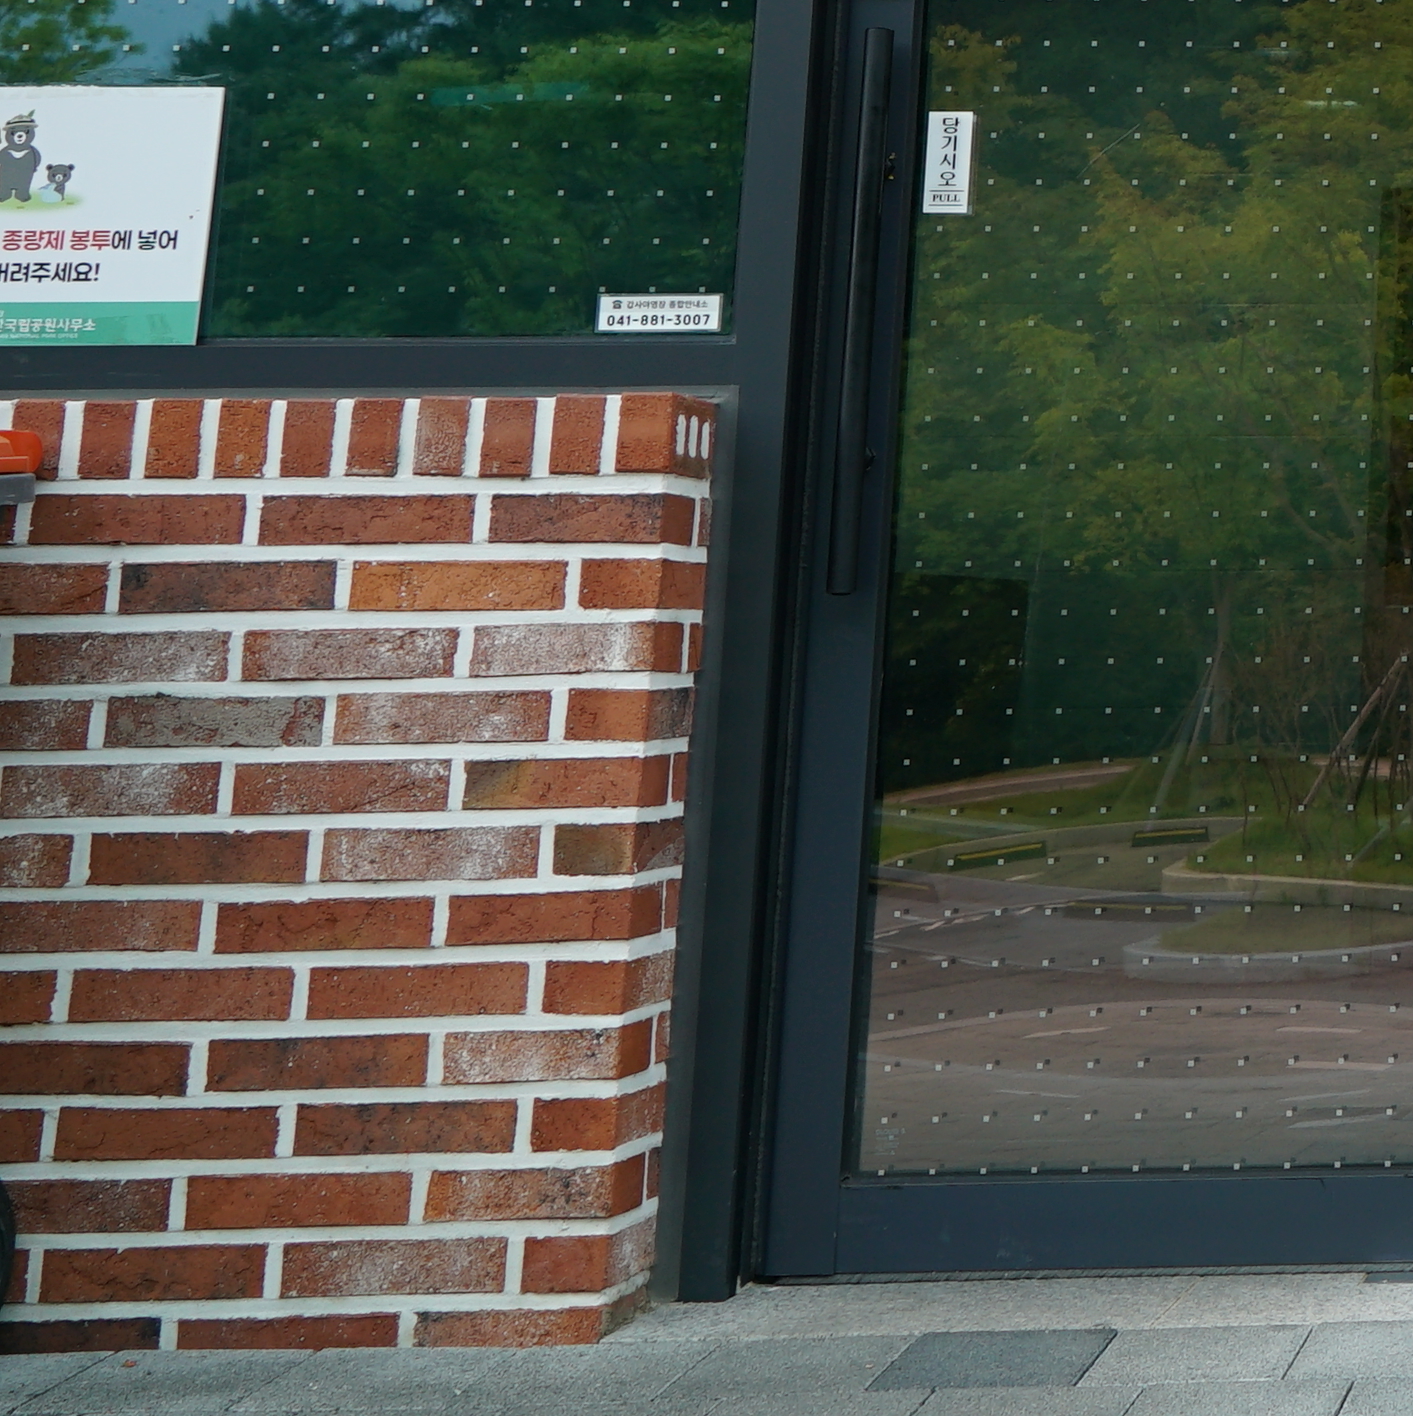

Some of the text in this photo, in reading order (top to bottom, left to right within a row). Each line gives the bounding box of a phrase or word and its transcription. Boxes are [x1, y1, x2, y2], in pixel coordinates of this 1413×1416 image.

[938, 117, 960, 186] 당기시오
[932, 194, 961, 202] PULL
[2, 230, 179, 251] 종량제 봉투에 넣어
[607, 314, 711, 326] 041-881-3007
